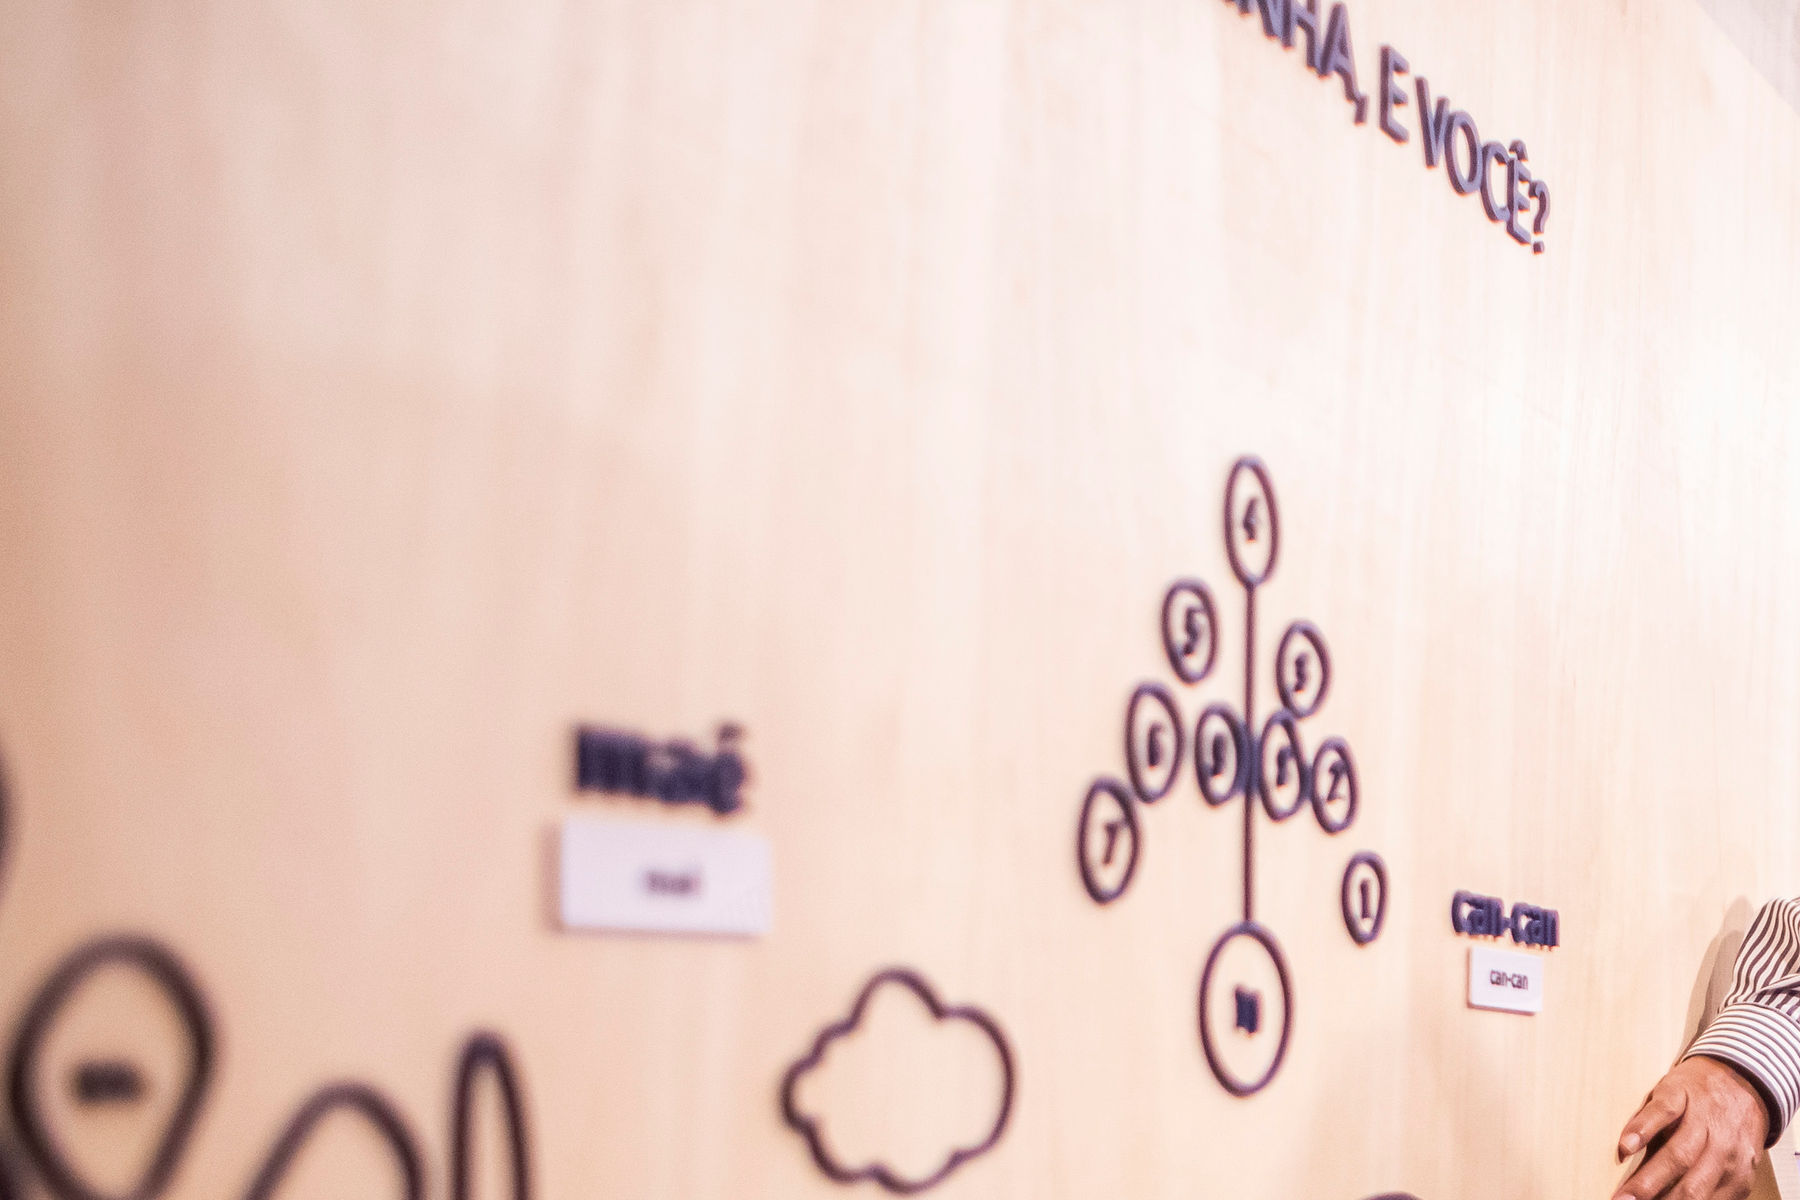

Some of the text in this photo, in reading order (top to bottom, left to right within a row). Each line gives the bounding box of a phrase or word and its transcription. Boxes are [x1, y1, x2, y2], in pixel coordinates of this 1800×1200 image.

[1378, 45, 1409, 143] E
[1414, 75, 1551, 255] VOCÊ?
[1451, 889, 1561, 948] can-can
[1489, 969, 1529, 990] can-can
